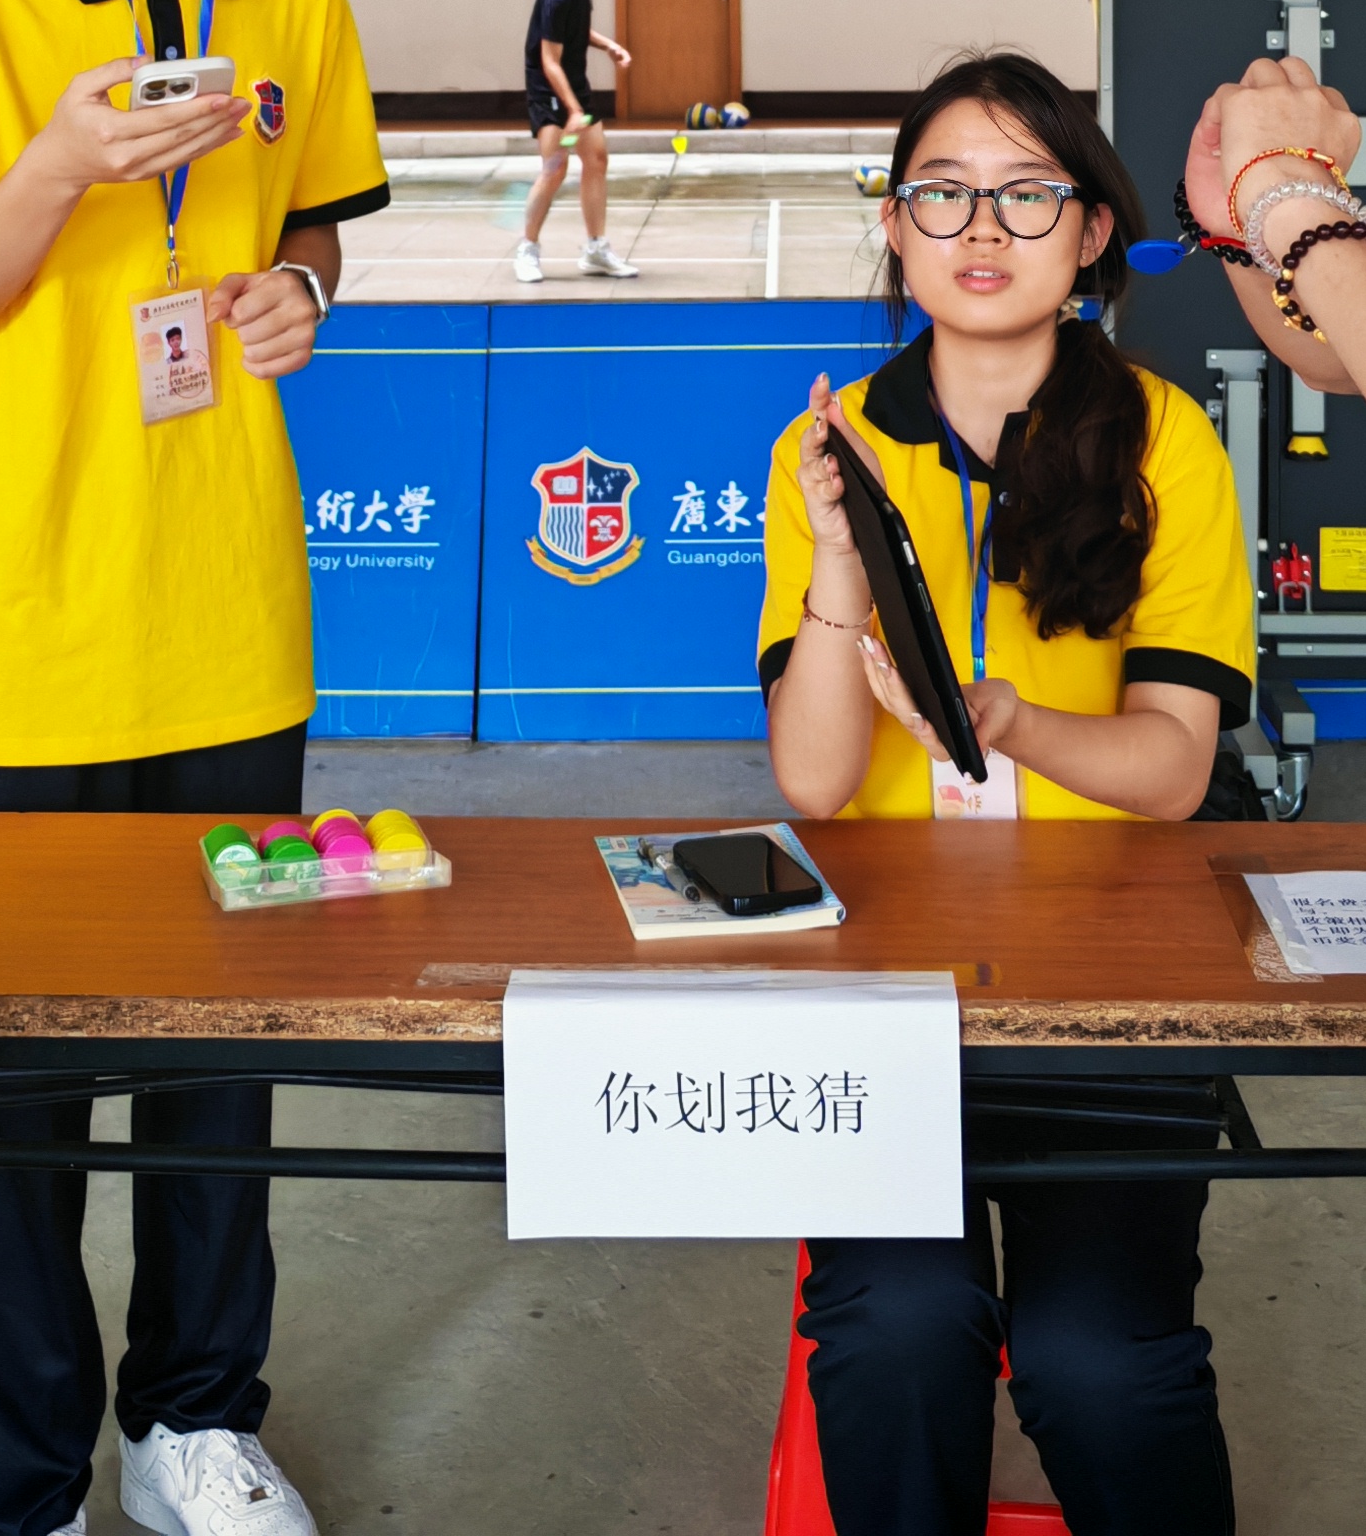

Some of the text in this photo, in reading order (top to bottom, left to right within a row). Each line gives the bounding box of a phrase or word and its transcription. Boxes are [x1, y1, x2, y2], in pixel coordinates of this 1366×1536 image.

[301, 484, 436, 534] 術大學
[670, 480, 765, 533] 廣東
[346, 553, 435, 571] University
[595, 1070, 869, 1133] 你划我猜
